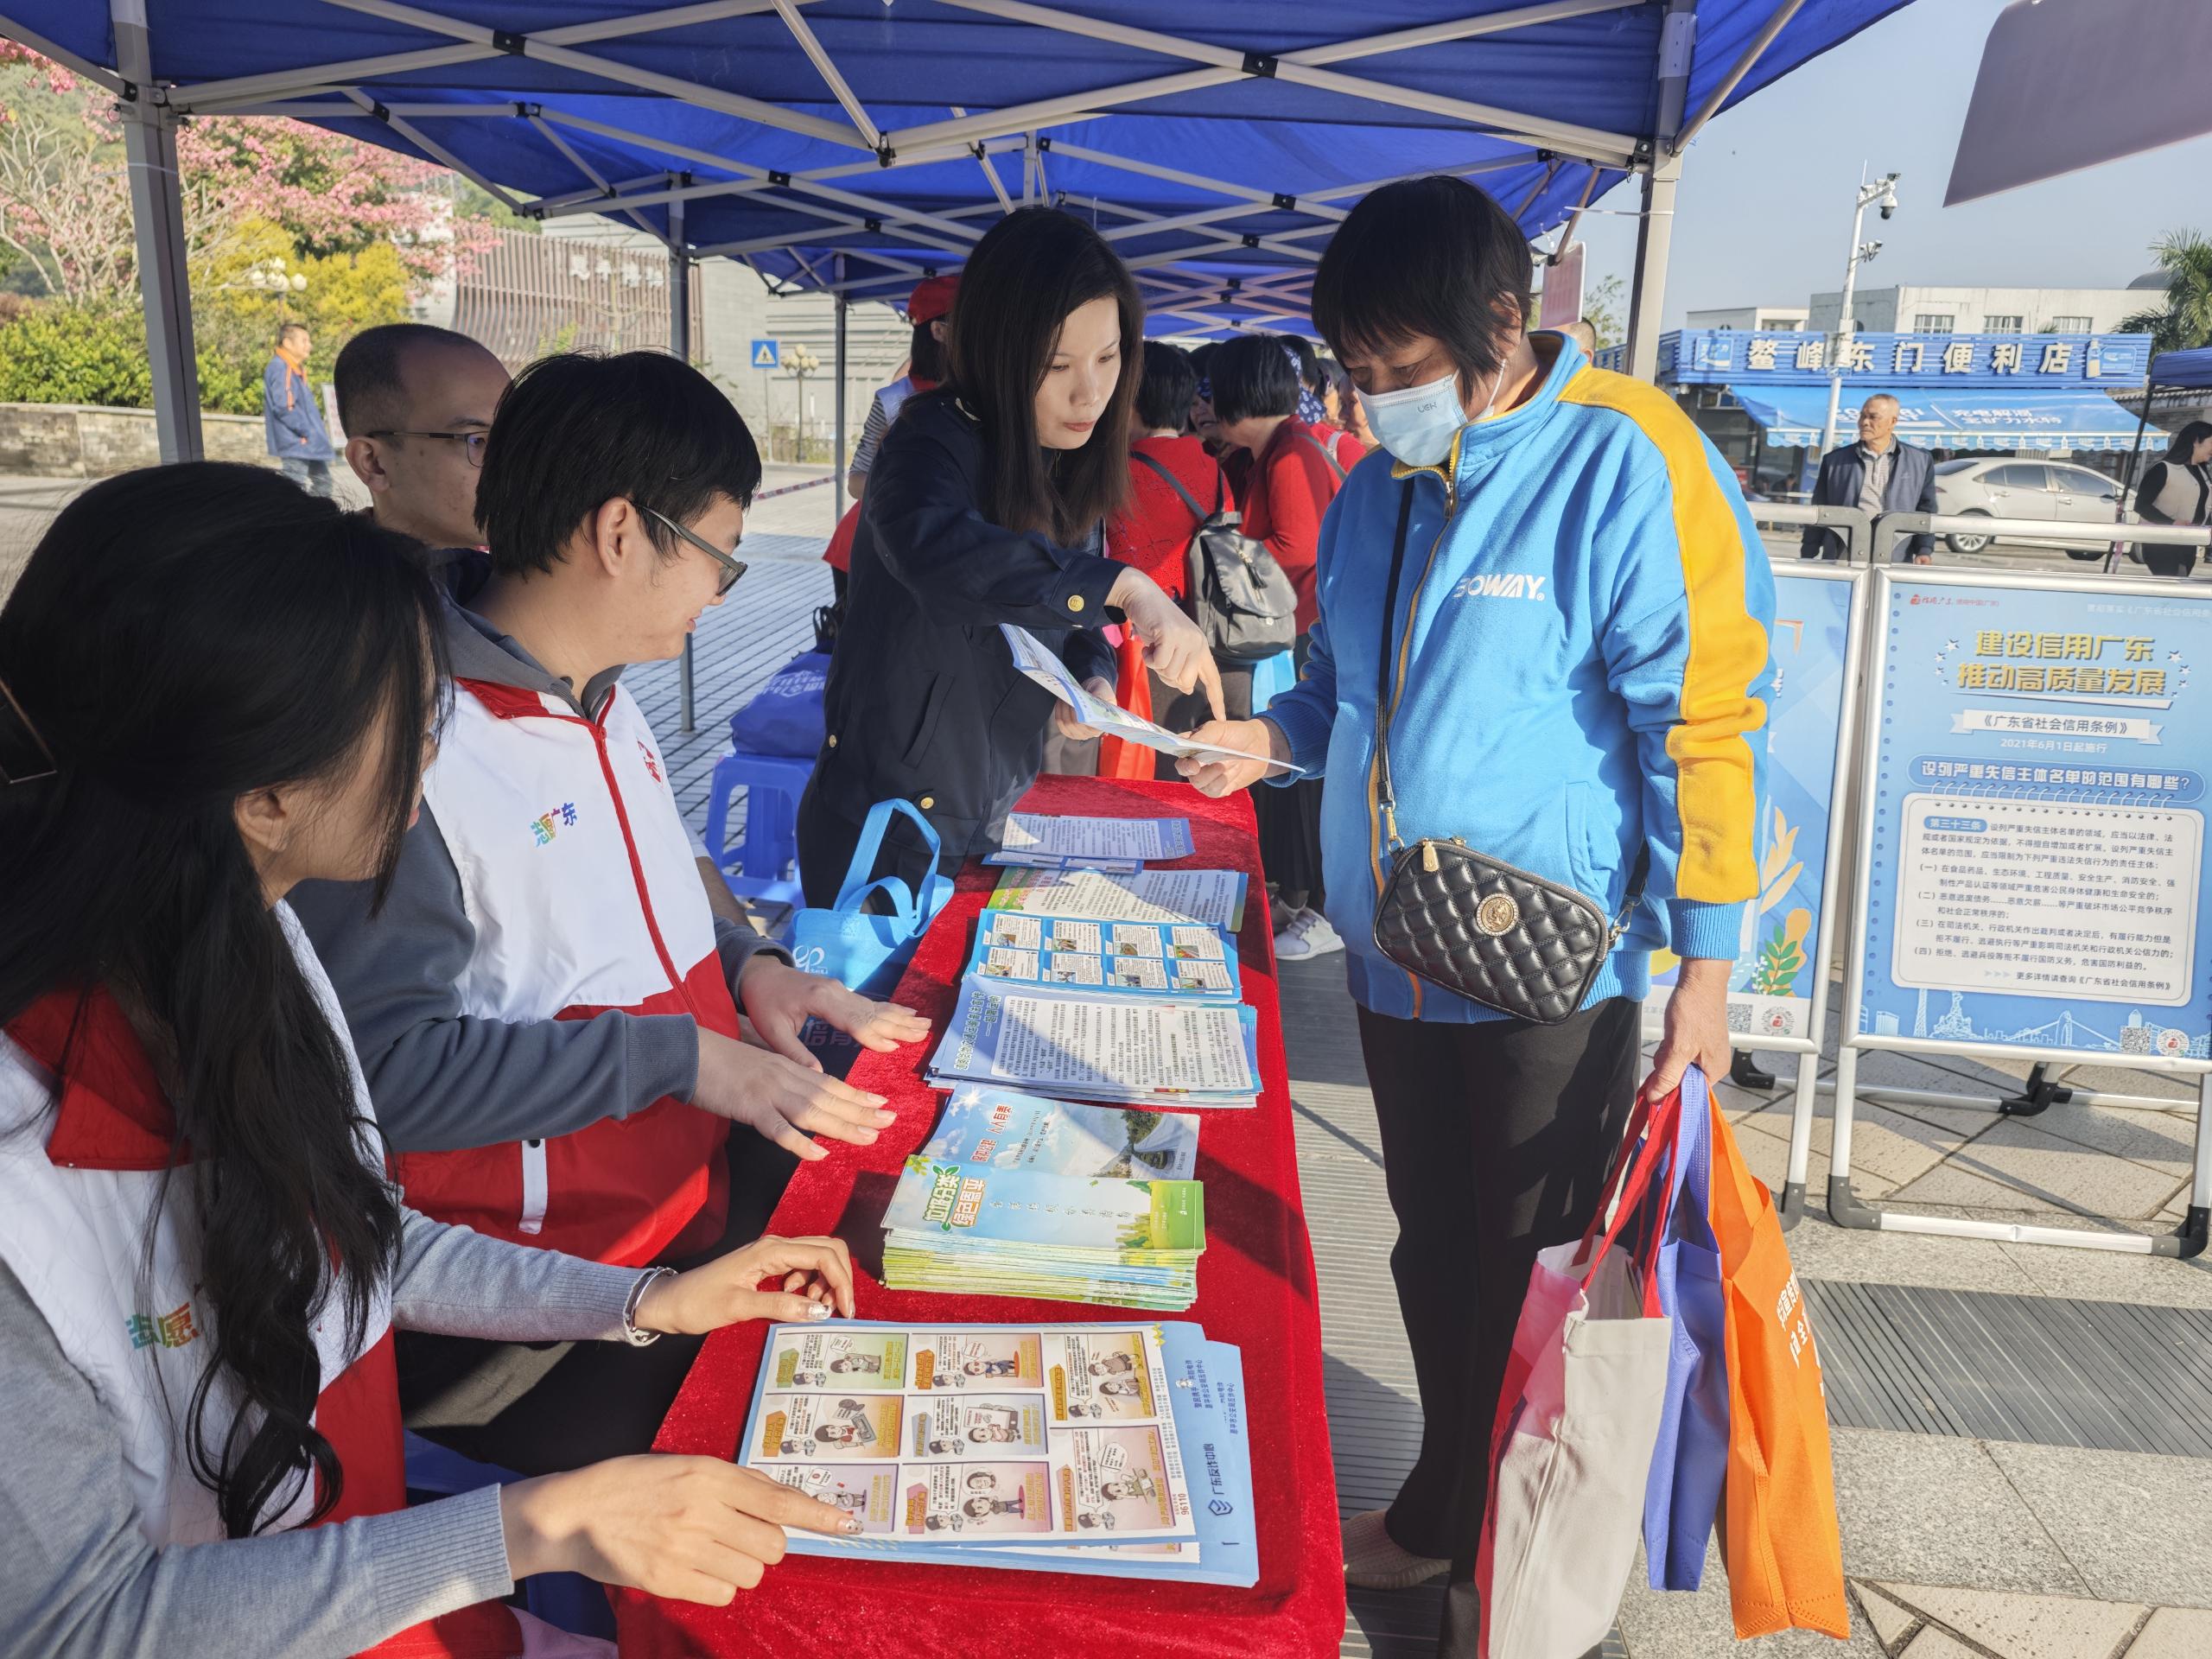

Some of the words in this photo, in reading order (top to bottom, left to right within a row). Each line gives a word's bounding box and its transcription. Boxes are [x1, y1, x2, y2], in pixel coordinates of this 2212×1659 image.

[1748, 338, 2074, 375] 鳌峰东门便利店
[1974, 629, 2156, 663] 建设信用广东
[1957, 662, 2166, 696] 推动高质量发展
[1984, 714, 2129, 735] 《广东省社会信用条例》
[1999, 738, 2108, 754] 2021年6月1日起施行
[1929, 817, 1982, 831] 第三十三条
[925, 1173, 960, 1224] 垃圾分类
[1203, 1443, 1224, 1495] 广东反诈中心
[1178, 1493, 1190, 1516] 96110
